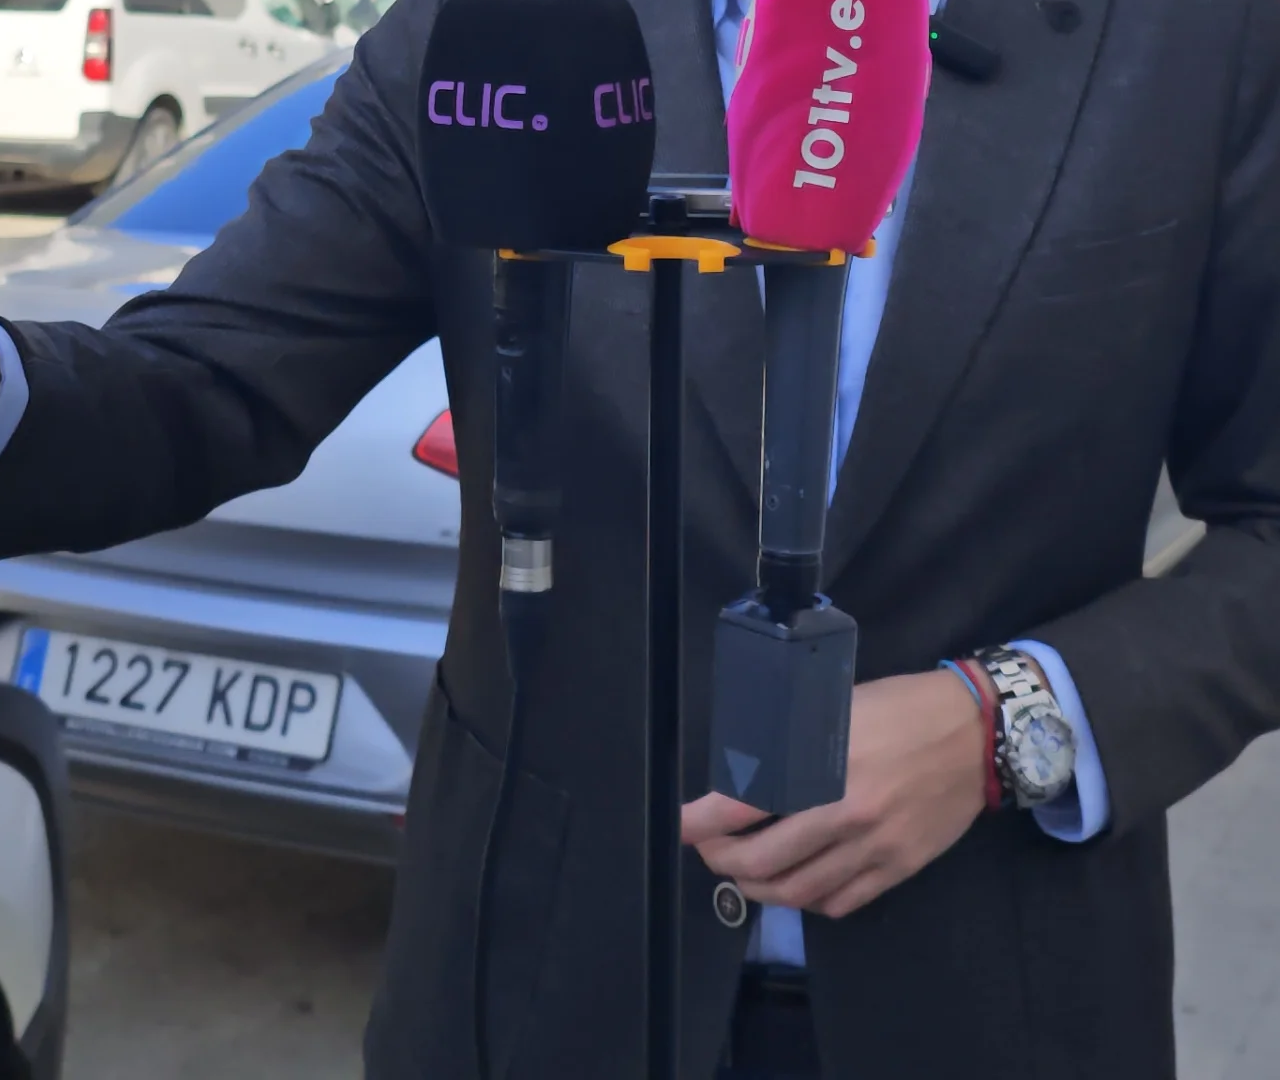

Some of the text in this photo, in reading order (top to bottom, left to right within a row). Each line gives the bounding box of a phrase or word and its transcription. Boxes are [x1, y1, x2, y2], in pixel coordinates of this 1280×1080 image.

[593, 77, 654, 129] CLIC
[63, 642, 318, 738] 1227 KDP
